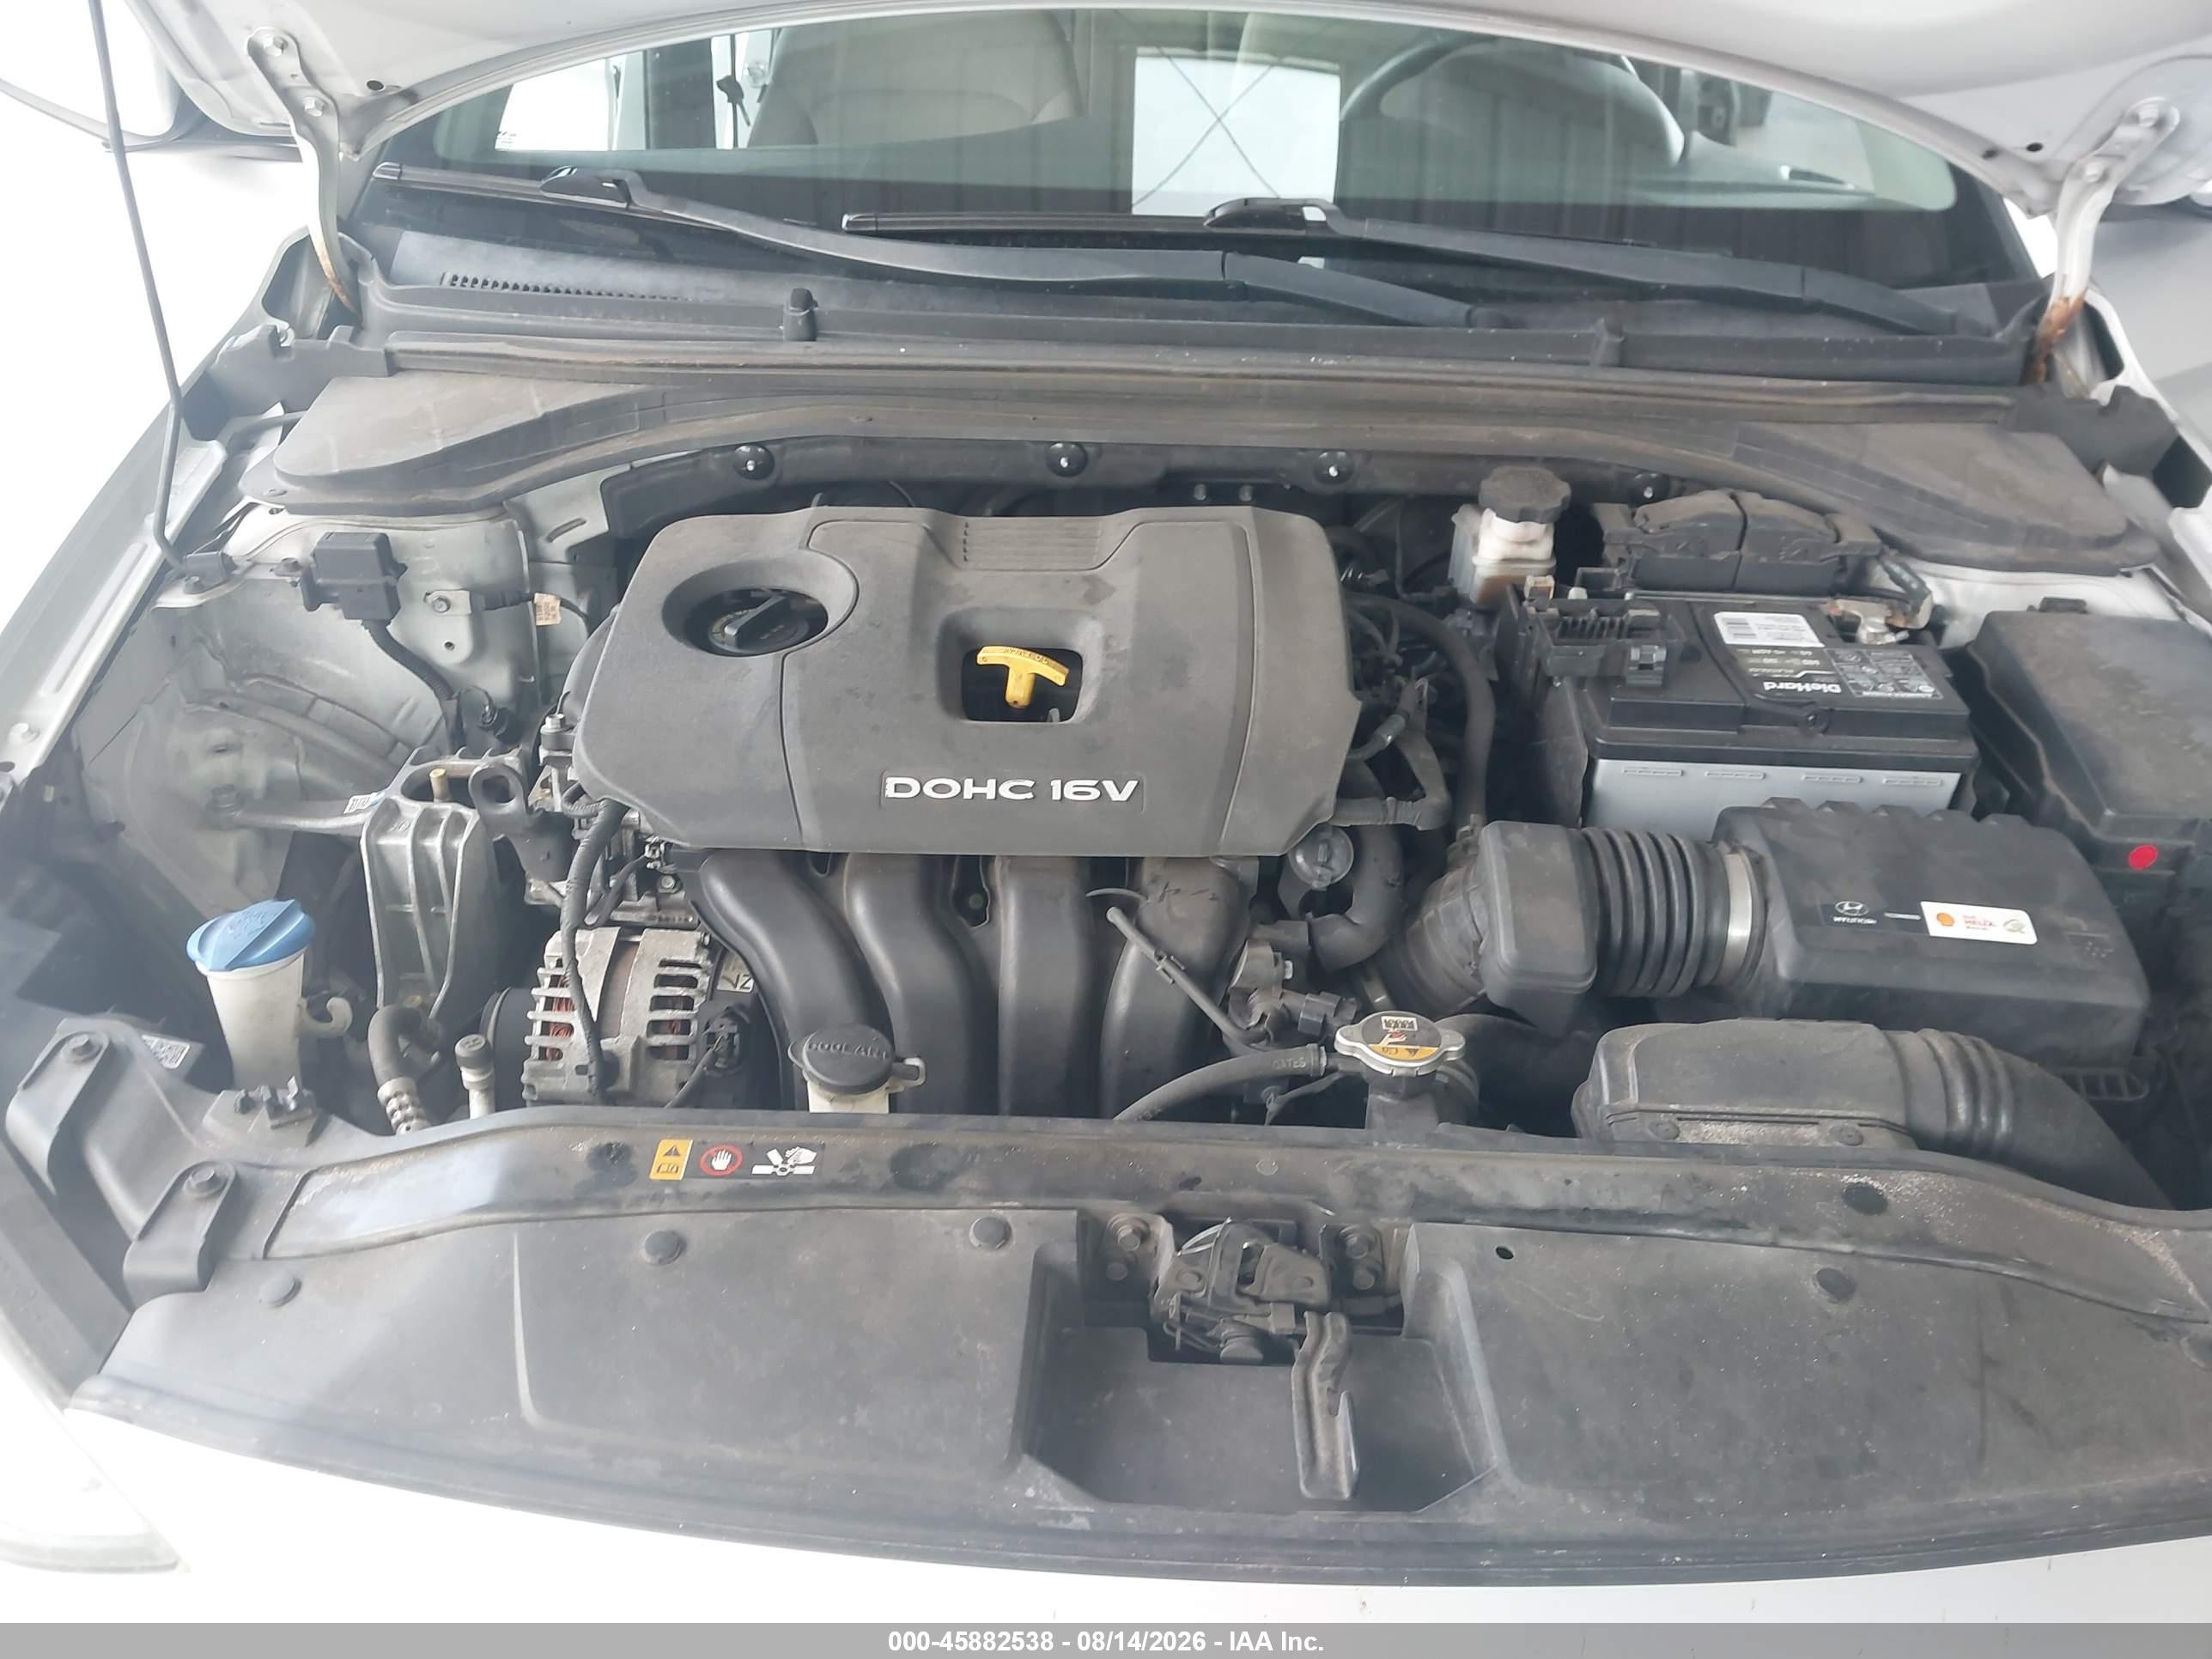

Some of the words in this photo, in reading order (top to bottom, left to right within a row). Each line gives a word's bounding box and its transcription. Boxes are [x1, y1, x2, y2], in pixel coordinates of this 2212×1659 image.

[1763, 681, 1842, 694] DieHard
[884, 776, 1036, 800] DOHC
[1050, 778, 1139, 801] 16V
[806, 1041, 890, 1060] COOLANT
